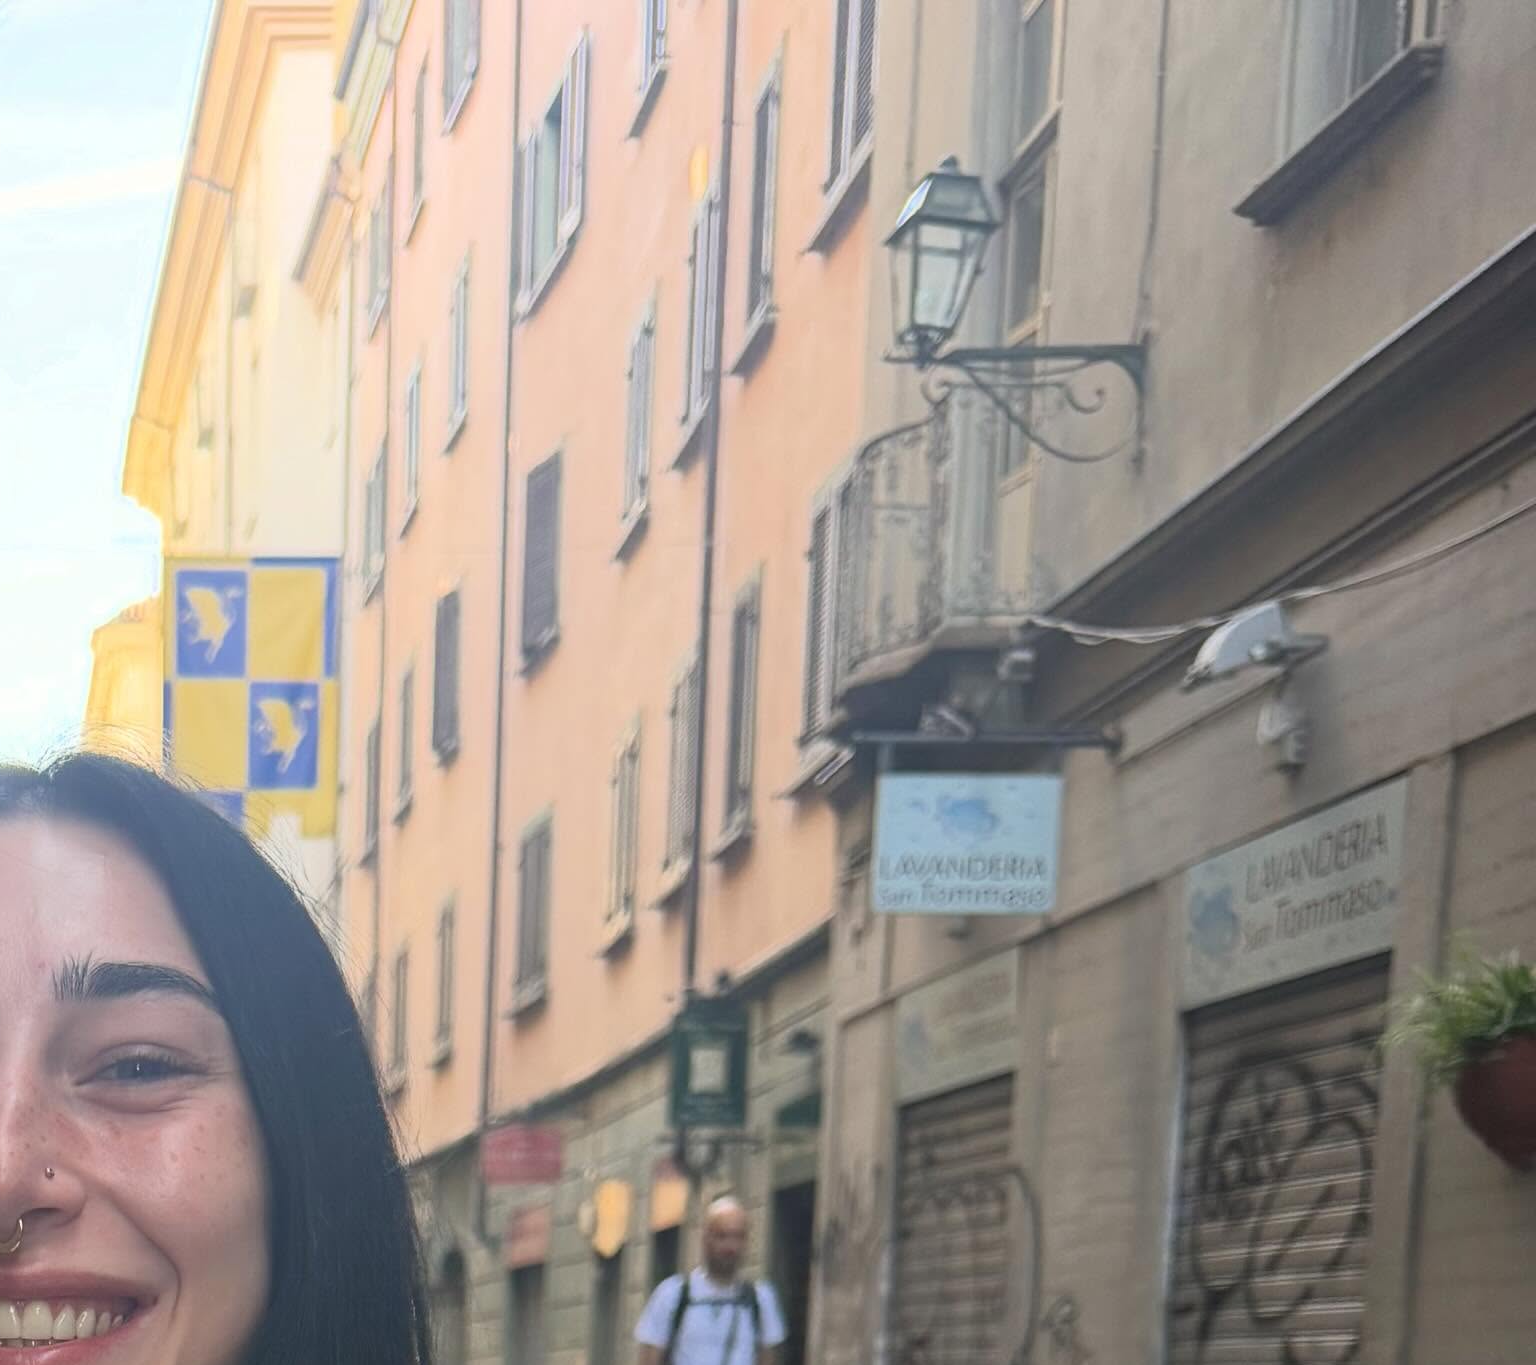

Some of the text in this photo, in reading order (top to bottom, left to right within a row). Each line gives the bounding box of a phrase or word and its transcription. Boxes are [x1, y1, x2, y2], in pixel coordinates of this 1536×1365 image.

[879, 854, 1047, 881] LAVANDERIA
[1246, 812, 1389, 904] LAVANDERIA
[921, 877, 1049, 905] Tommaso
[1274, 878, 1385, 940] Tommaso
